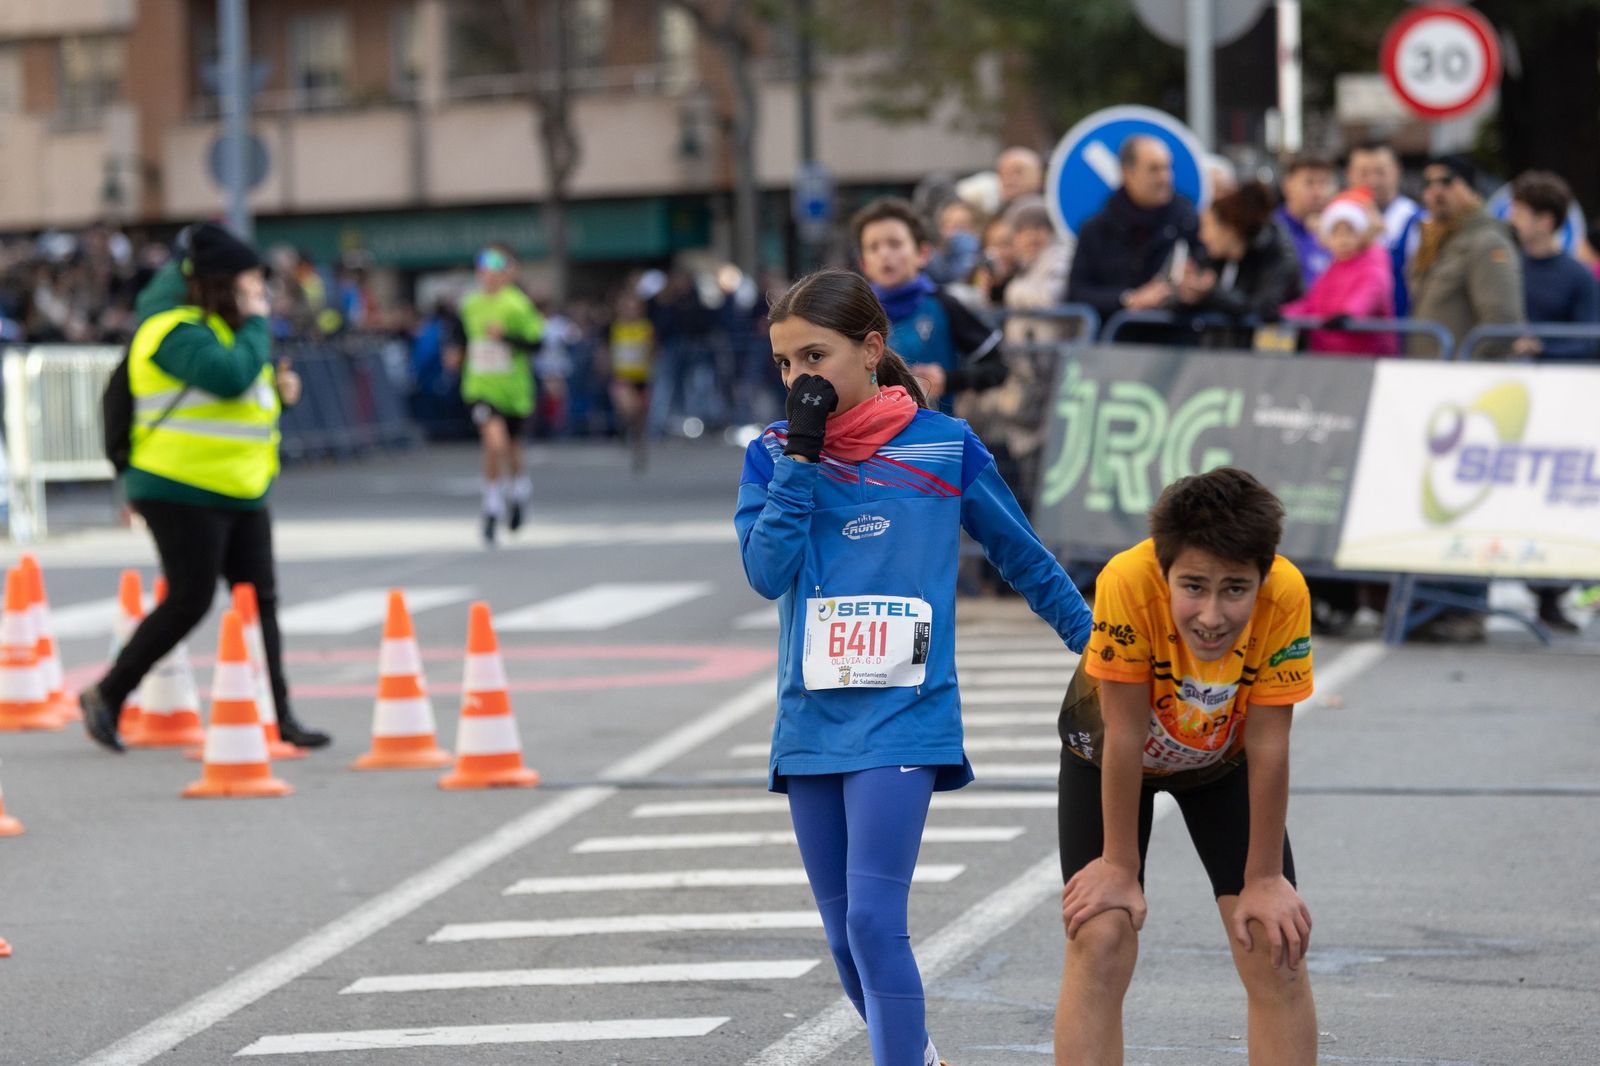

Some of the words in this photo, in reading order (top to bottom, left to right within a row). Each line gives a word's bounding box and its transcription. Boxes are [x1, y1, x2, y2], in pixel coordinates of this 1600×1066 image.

[1408, 42, 1474, 84] 30
[1042, 362, 1245, 512] JRG
[1455, 446, 1600, 486] SETEL
[842, 520, 891, 536] CRONOS
[837, 601, 919, 618] SETEL
[828, 621, 888, 657] 6411
[852, 671, 888, 680] Ayuntamiento
